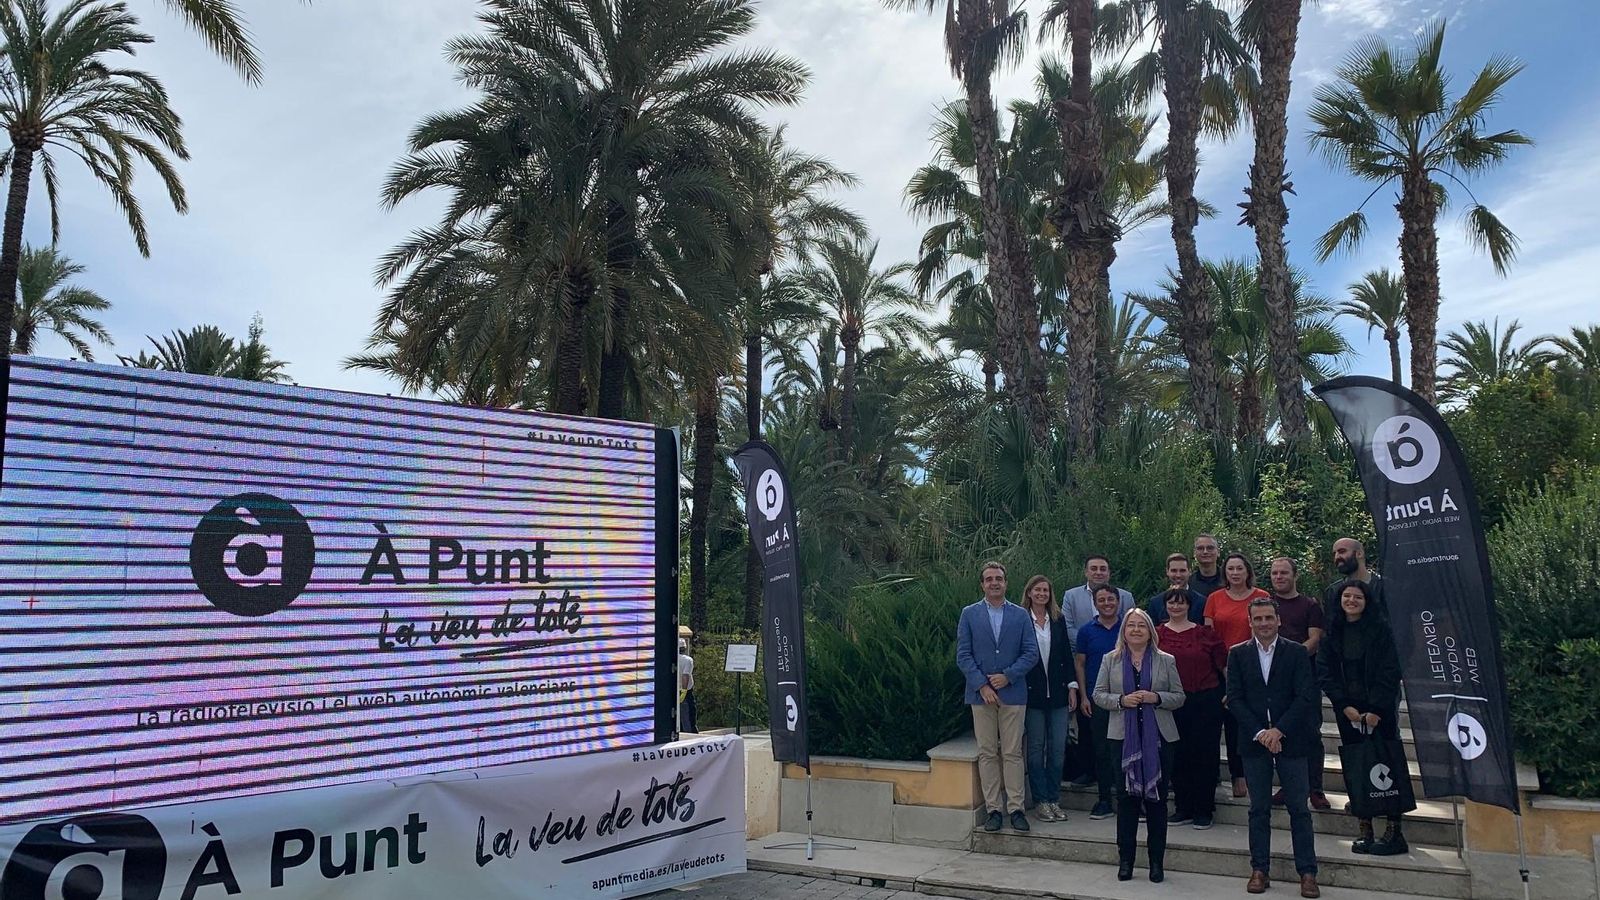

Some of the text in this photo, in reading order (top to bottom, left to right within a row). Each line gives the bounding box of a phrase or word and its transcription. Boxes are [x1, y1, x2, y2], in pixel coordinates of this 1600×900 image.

[527, 431, 638, 449] #LaVeuDeTots
[358, 522, 552, 585] À Punt
[378, 589, 585, 650] La veu de tots
[358, 691, 396, 707] web
[632, 742, 727, 762] #LaVeuDeTots
[475, 771, 698, 867] La veu de tots
[179, 812, 428, 900] À Punt
[592, 852, 726, 890] apuntmedia.es/laveudetots
